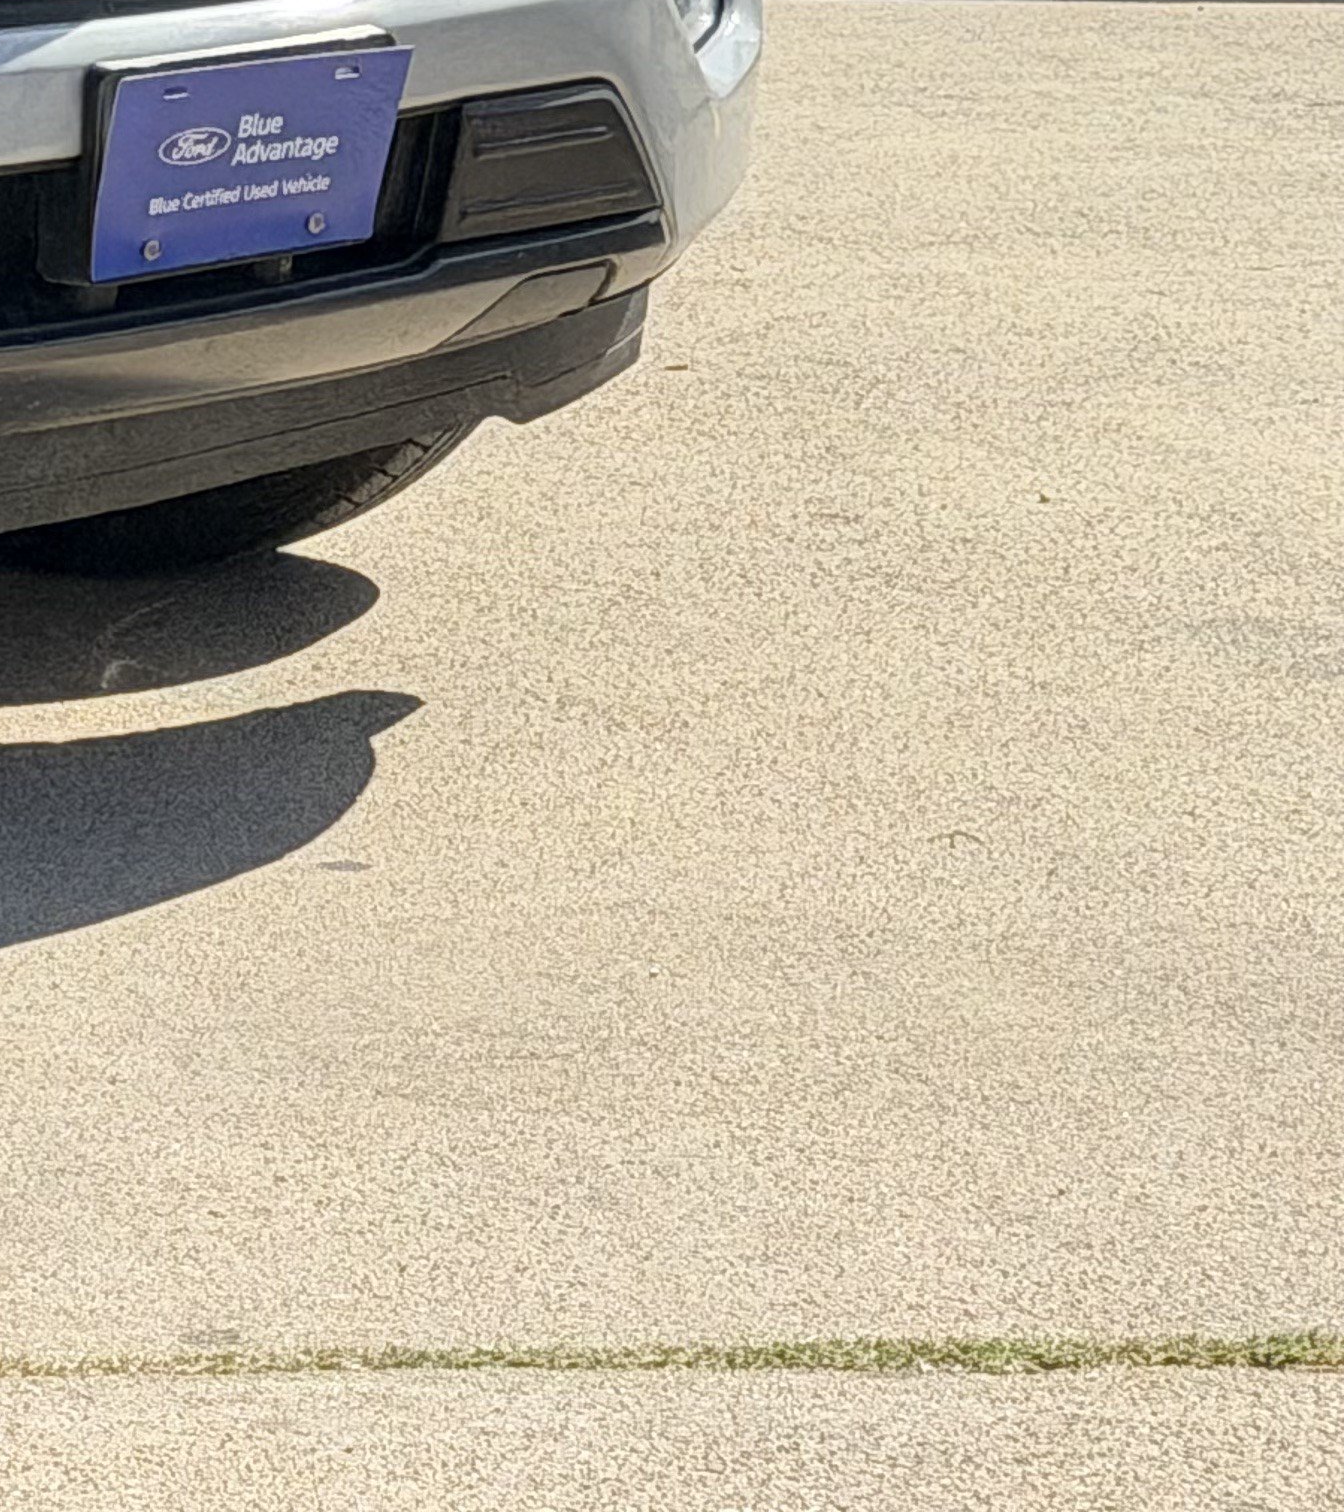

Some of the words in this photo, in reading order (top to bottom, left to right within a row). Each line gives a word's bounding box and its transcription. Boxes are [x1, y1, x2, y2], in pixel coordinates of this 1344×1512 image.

[170, 132, 219, 161] Ford
[237, 112, 284, 139] Blue
[230, 135, 340, 167] Advantage
[148, 196, 180, 216] Blue
[183, 184, 241, 211] Certified
[243, 179, 279, 202] Used
[281, 171, 332, 196] Vehicle
